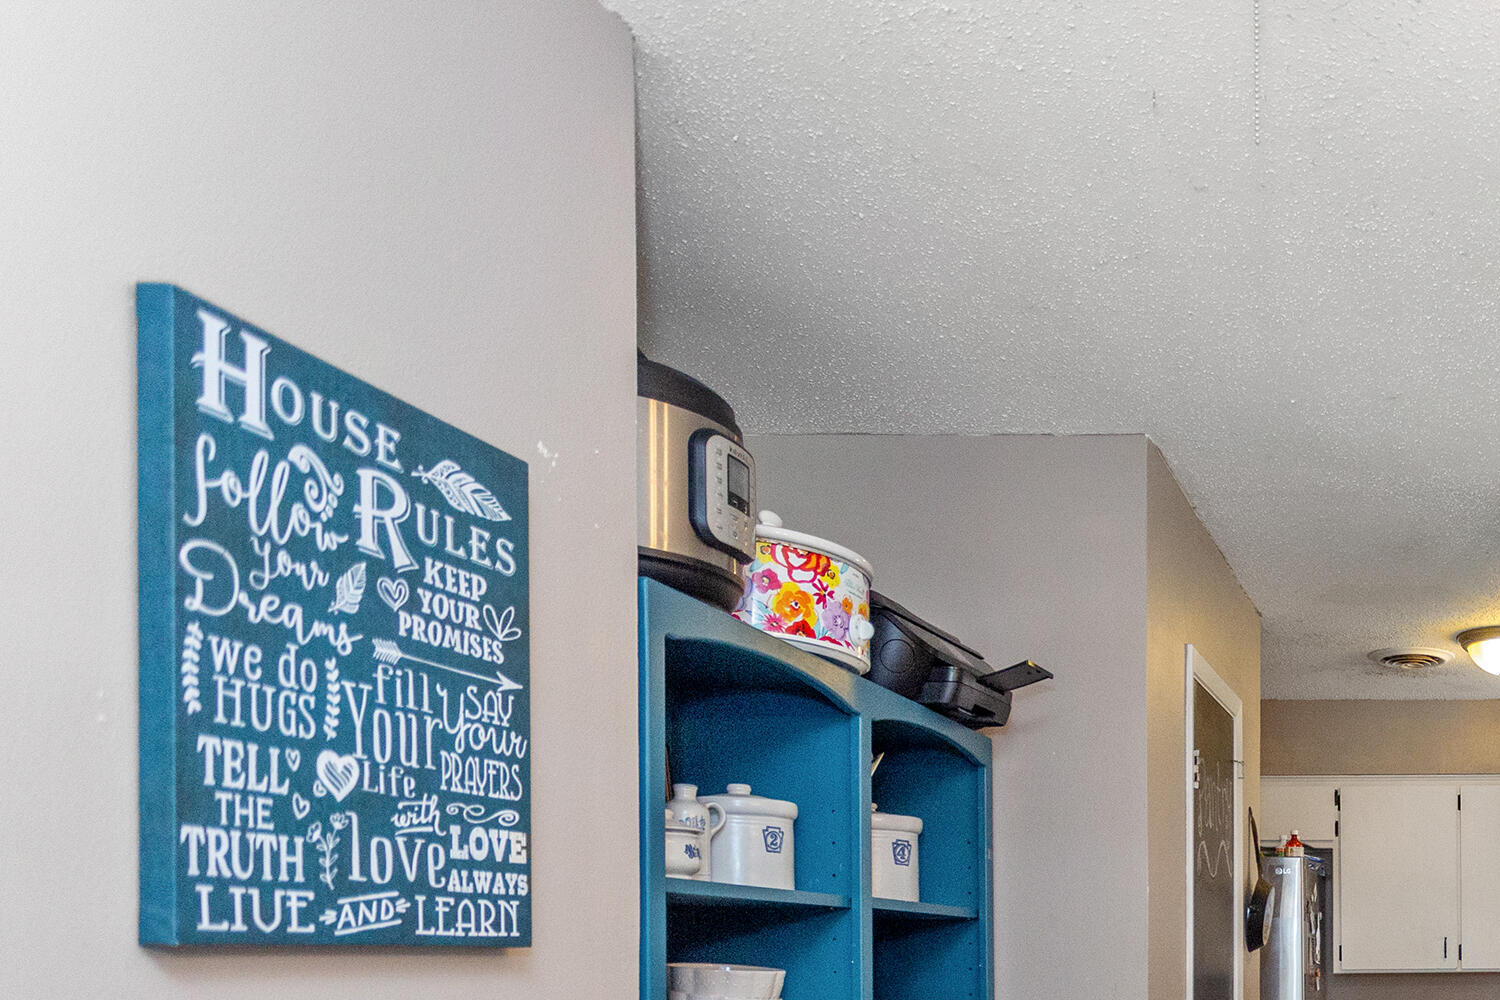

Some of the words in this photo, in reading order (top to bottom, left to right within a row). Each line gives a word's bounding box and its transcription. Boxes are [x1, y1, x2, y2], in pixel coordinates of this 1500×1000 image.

[190, 308, 405, 473] HOUSE
[352, 467, 517, 576] RULES
[178, 539, 364, 656] Dreams
[423, 557, 488, 602] KEEP
[417, 587, 483, 631] YOUR
[207, 634, 263, 680] we
[278, 642, 318, 694] do
[399, 611, 505, 665] PROMISES
[212, 674, 317, 740] HUGS
[373, 664, 434, 715] fill
[465, 685, 515, 727] SAY
[197, 734, 291, 796] TELL
[439, 750, 523, 801] PRAYERS
[214, 792, 275, 831] THE
[391, 793, 447, 836] with
[180, 824, 306, 884] TRUTH
[345, 811, 446, 889] love
[449, 825, 528, 865] LOVE
[446, 868, 529, 897] ALWAYS
[194, 884, 316, 934] LIVE
[336, 898, 398, 930] AND
[415, 895, 521, 938] LEARN
